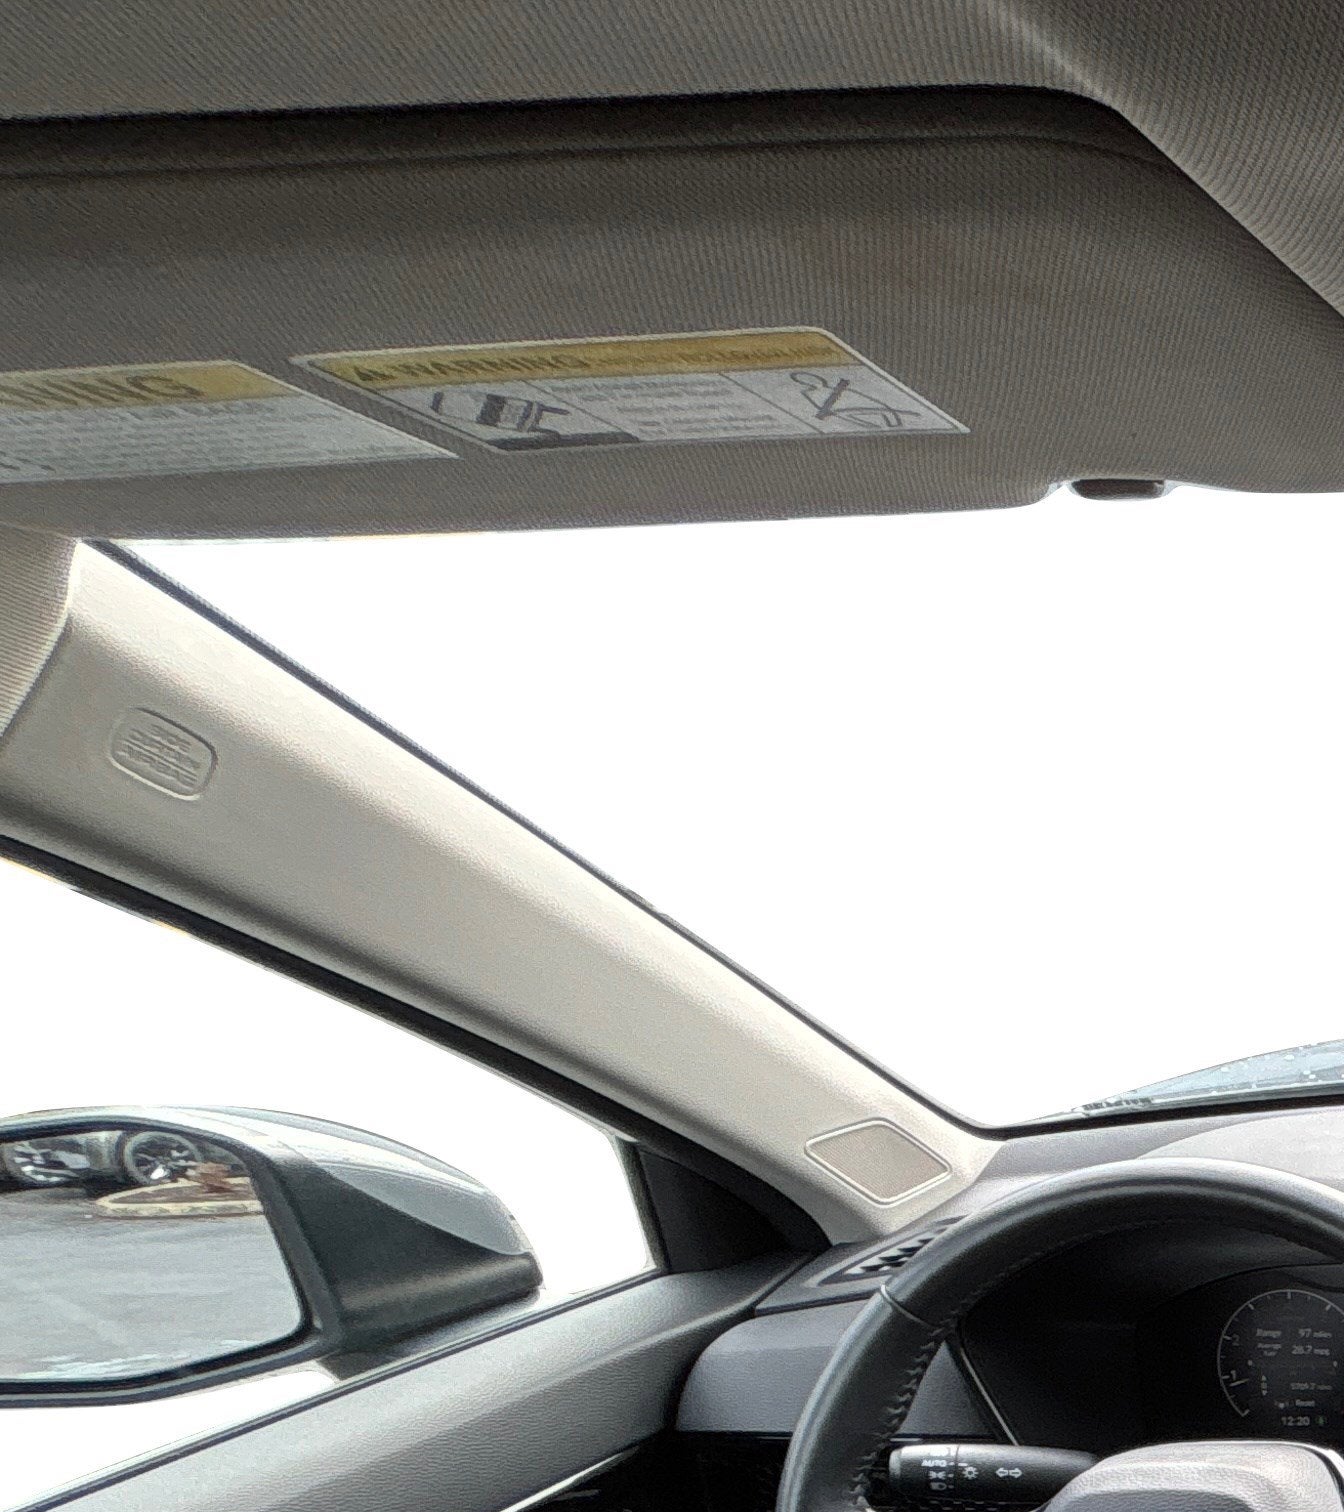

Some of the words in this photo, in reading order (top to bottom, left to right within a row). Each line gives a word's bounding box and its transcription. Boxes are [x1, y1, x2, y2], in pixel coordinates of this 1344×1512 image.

[399, 353, 592, 377] WARNING
[0, 374, 206, 406] NING
[1280, 1416, 1311, 1427] 12:20
[921, 1459, 948, 1468] AUTO
